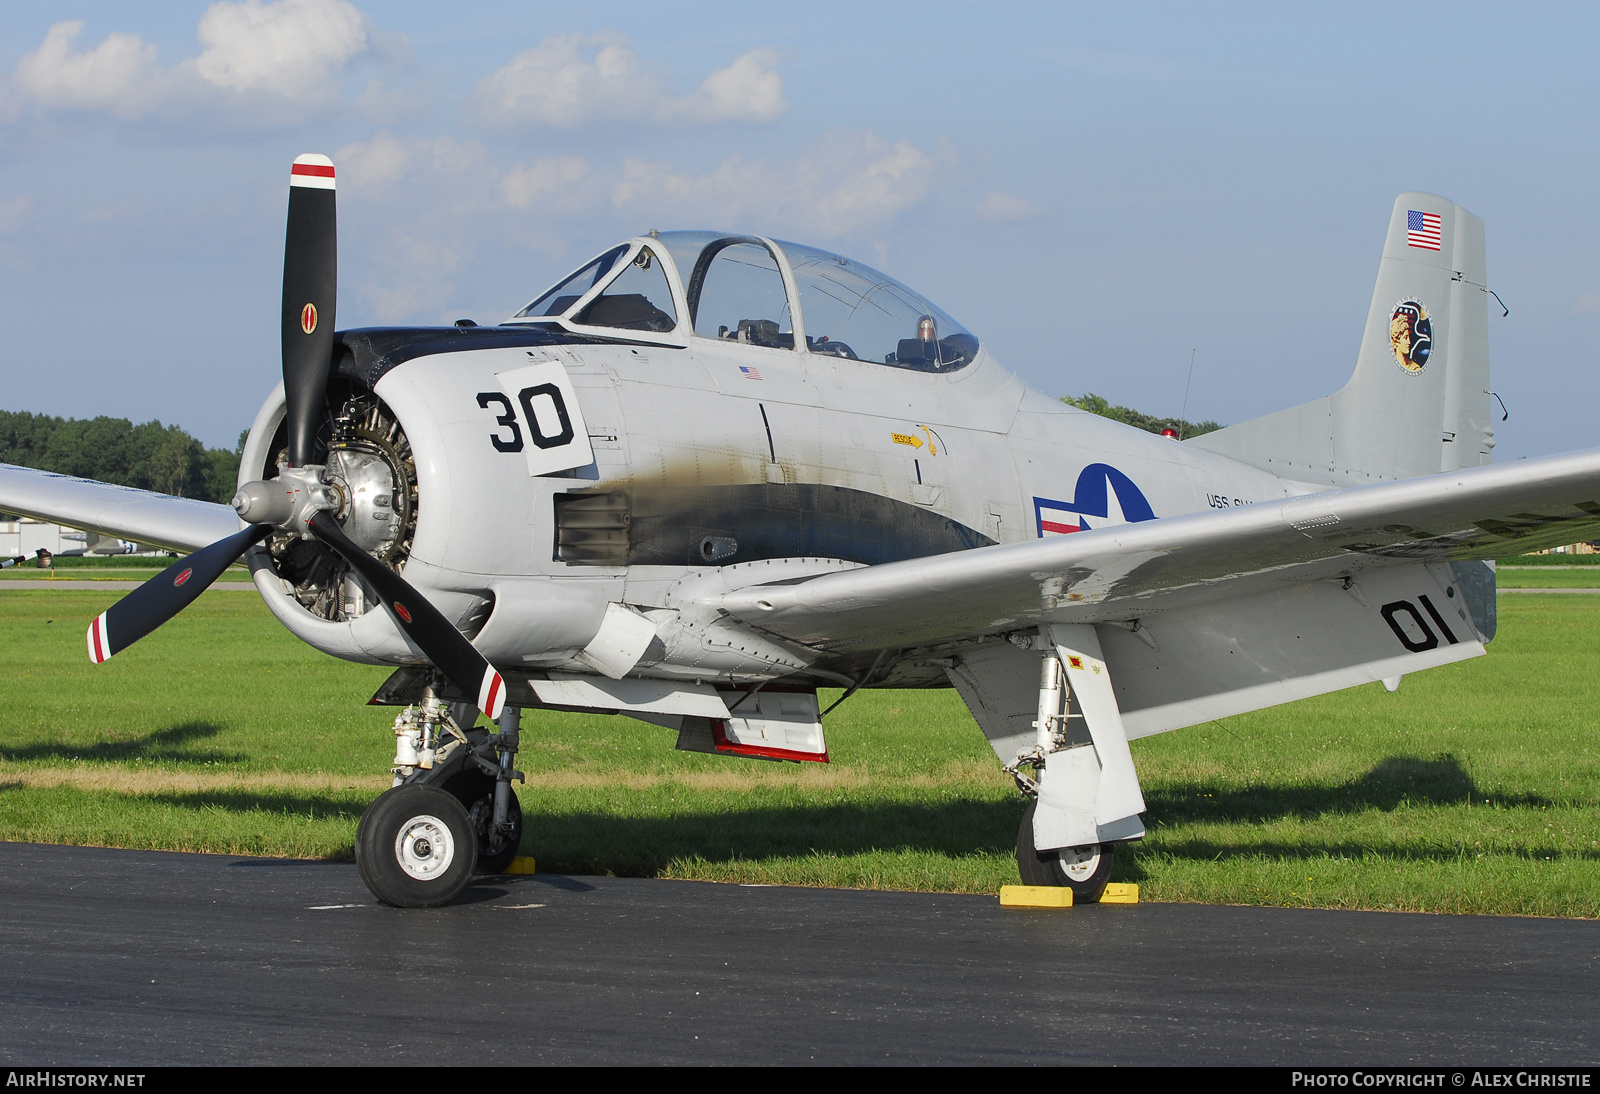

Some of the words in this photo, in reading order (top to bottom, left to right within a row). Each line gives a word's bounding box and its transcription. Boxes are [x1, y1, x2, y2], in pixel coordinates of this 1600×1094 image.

[475, 382, 575, 453] 30
[893, 434, 914, 445] RESCUE
[1206, 492, 1230, 509] USS
[1380, 594, 1460, 653] 01
